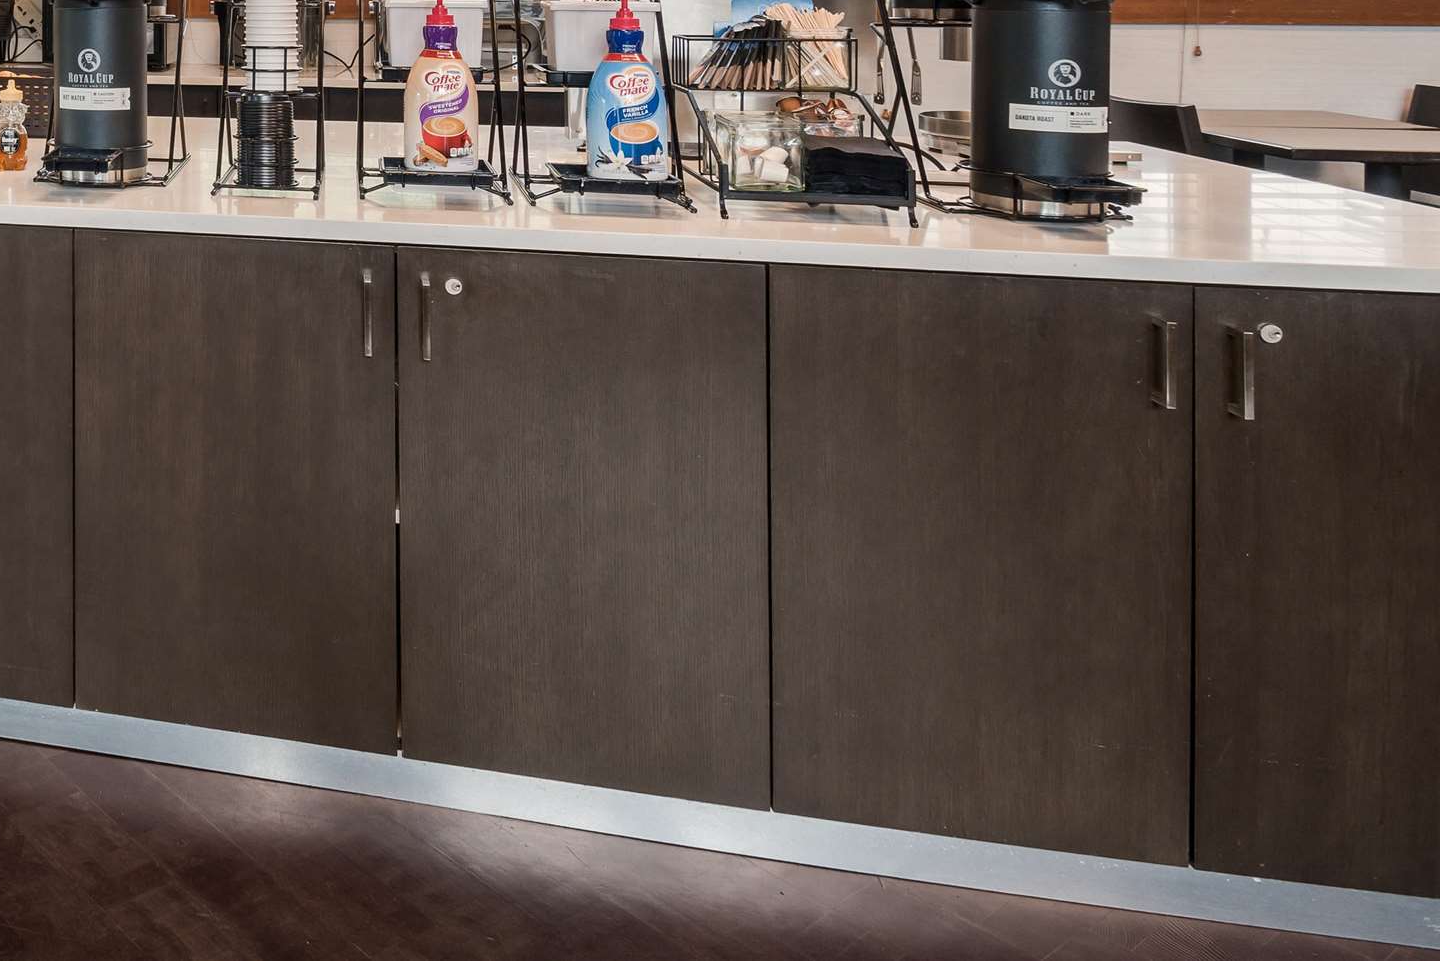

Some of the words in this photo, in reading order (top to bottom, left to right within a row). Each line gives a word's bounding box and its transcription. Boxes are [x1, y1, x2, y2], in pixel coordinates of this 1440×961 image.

[68, 72, 95, 84] ROYAL
[96, 72, 114, 84] CUP
[425, 71, 461, 86] Coffee
[609, 75, 649, 89] Coffee
[433, 83, 459, 93] mate
[620, 86, 648, 96] mate
[1030, 87, 1073, 100] ROYAL
[1074, 88, 1096, 101] CUP
[433, 106, 459, 114] ORIGINAL
[622, 104, 649, 113] FRENCH
[623, 109, 649, 118] VANILLA
